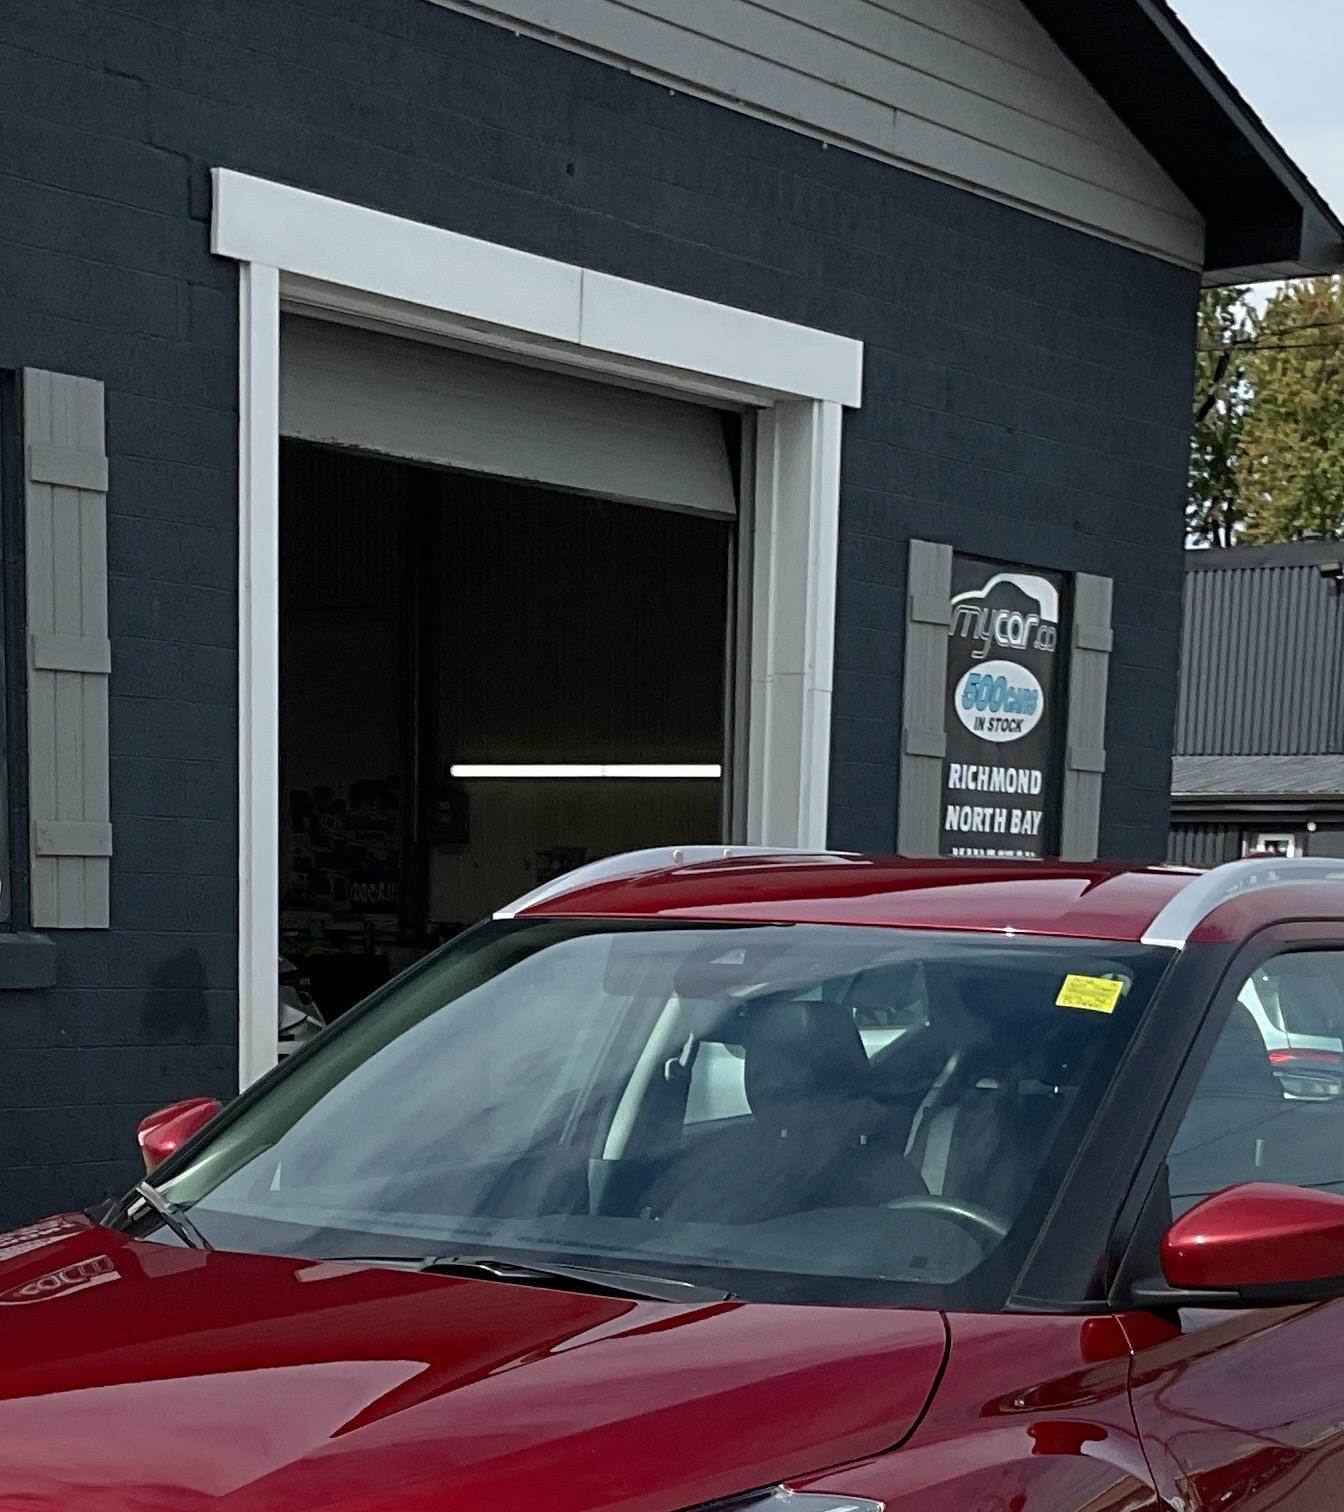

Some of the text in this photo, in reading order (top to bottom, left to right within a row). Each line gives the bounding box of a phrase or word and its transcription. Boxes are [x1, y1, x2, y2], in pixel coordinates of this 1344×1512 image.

[973, 716, 1025, 733] IN STOCK
[948, 763, 1043, 795] RICHMOND
[945, 804, 1043, 835] NORTH BAY
